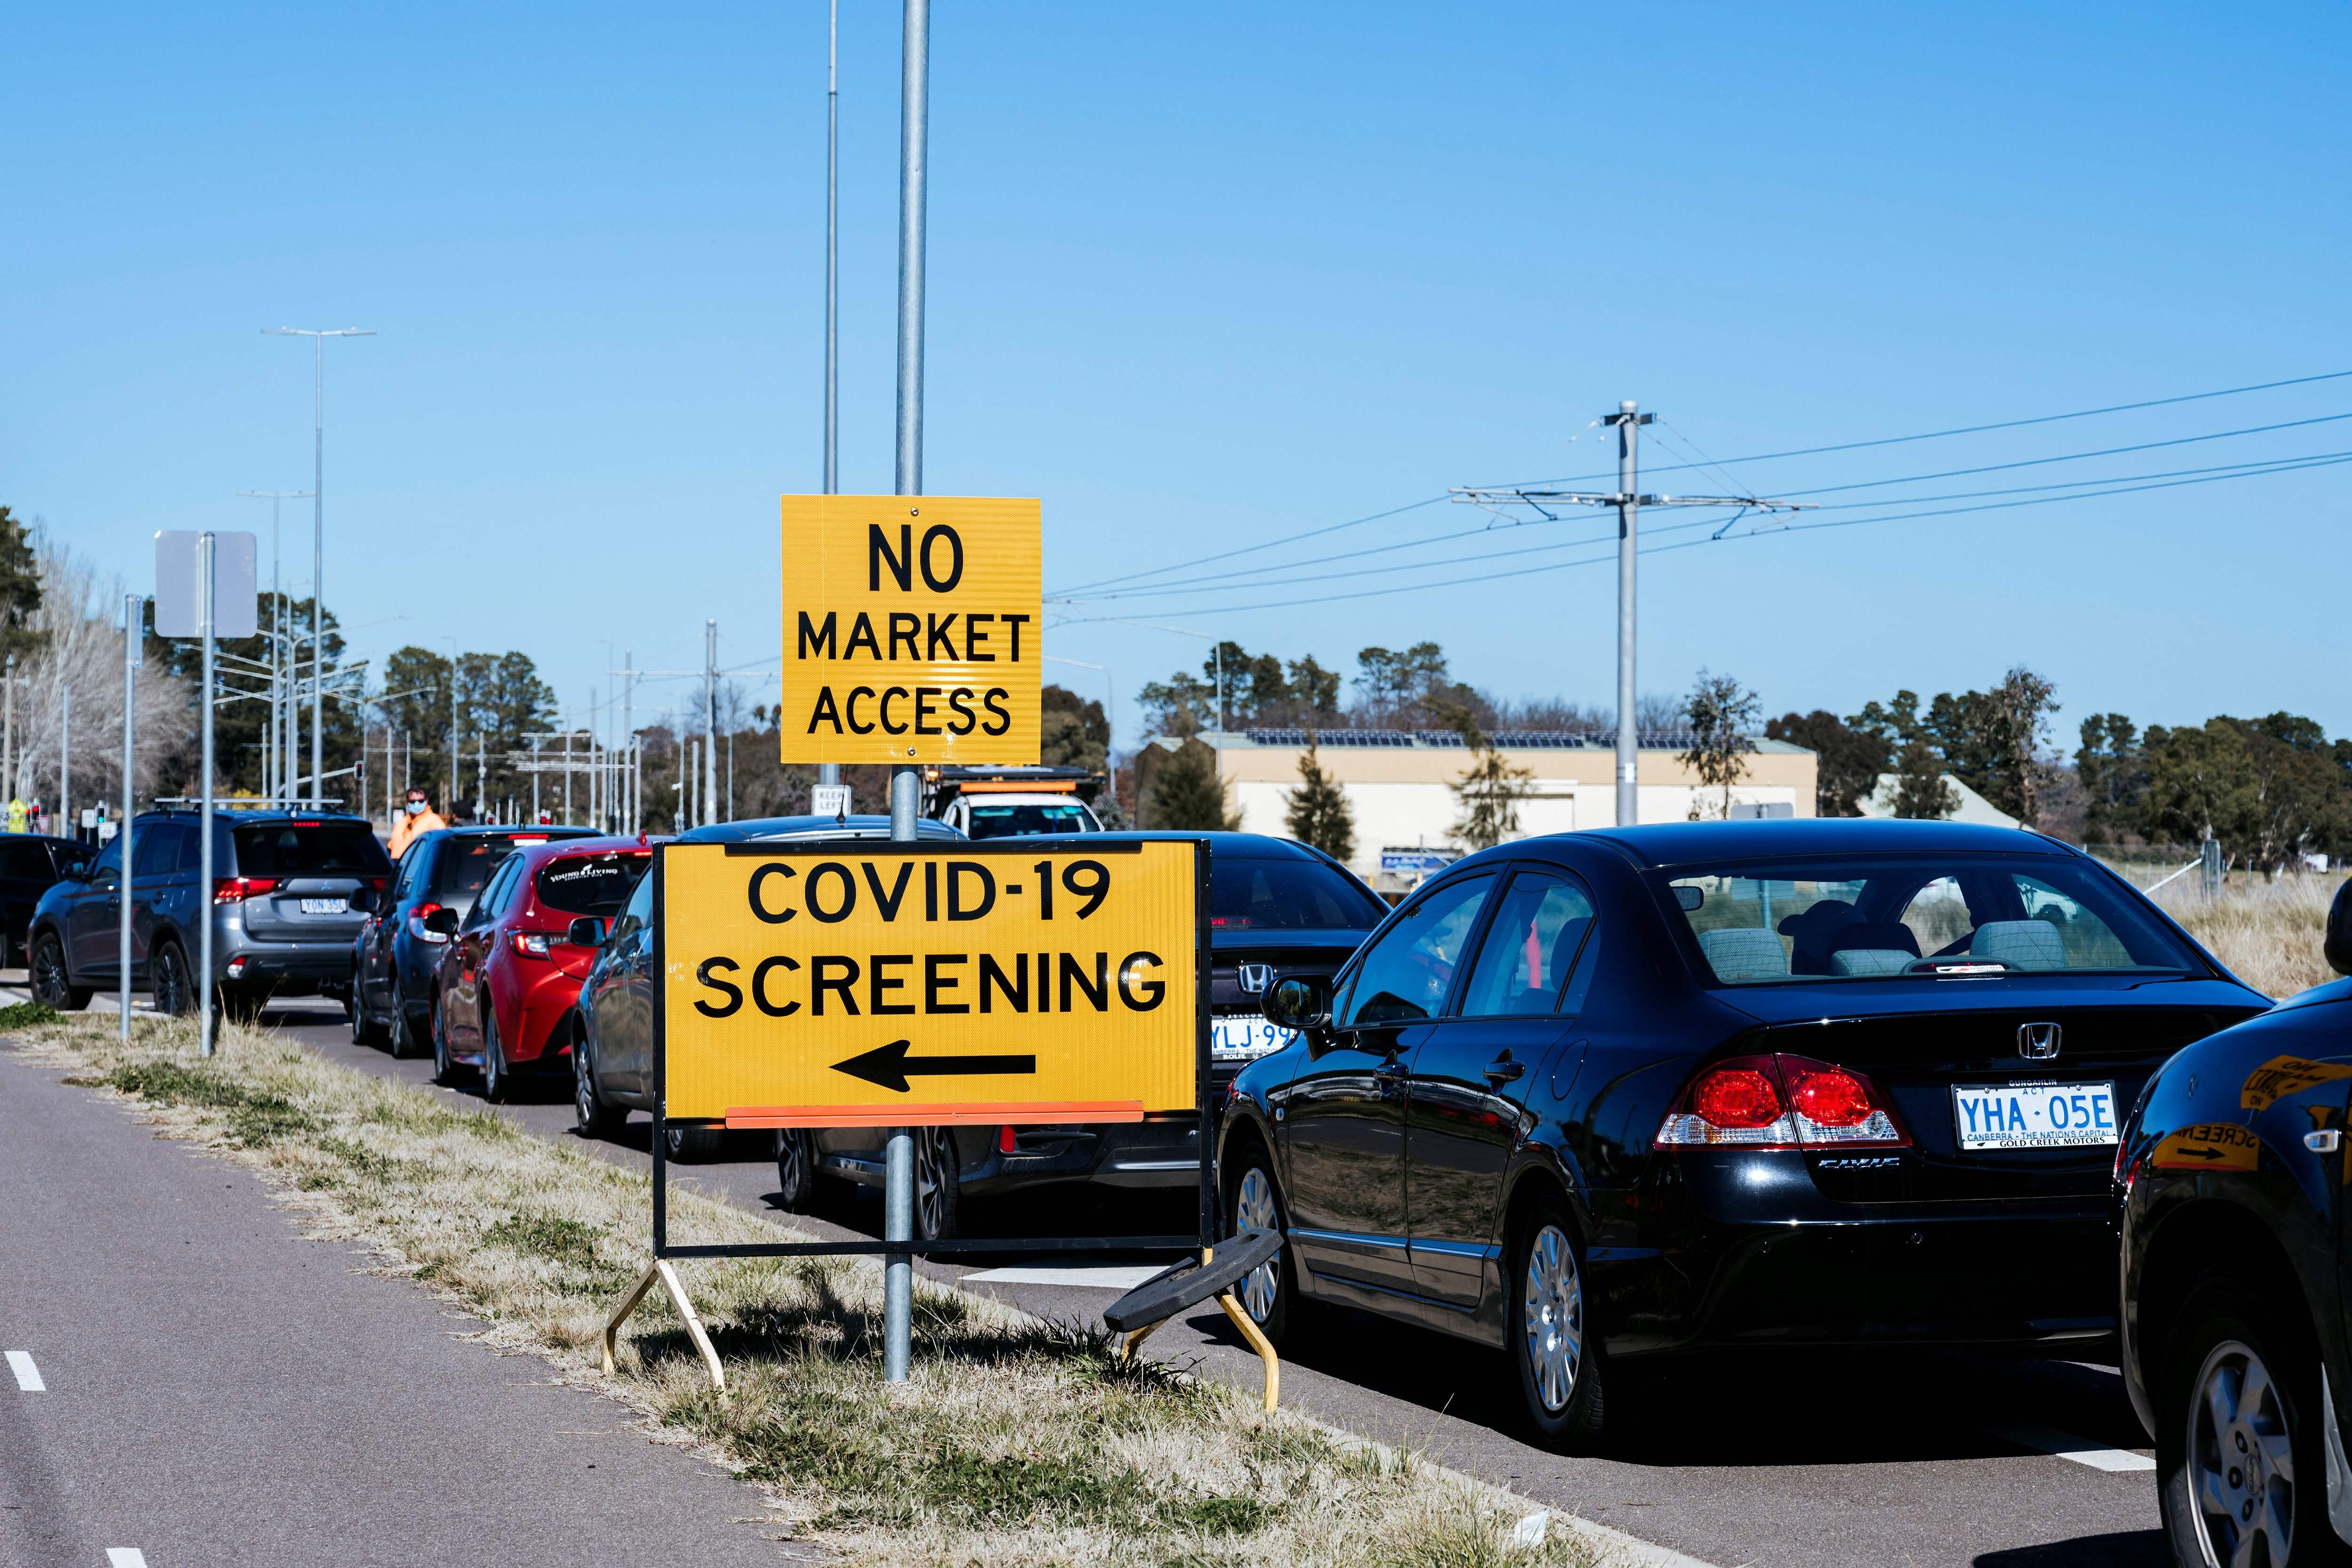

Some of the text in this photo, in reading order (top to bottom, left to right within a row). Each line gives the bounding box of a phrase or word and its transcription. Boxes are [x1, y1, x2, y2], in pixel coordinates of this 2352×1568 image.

[869, 523, 963, 593] NO
[798, 611, 1030, 662] MARKET
[807, 686, 1010, 736] ACCESS
[550, 871, 580, 882] YOUNG
[748, 860, 1111, 924] COVID-19
[693, 951, 1165, 1018] SCREENING
[1212, 1025, 1297, 1048] YLJ·99
[1967, 1133, 2012, 1141] CANBERRA
[2030, 1138, 2059, 1147] CREEK
[2064, 1136, 2105, 1145] MOTORS
[1818, 1157, 1900, 1171] CIVIC
